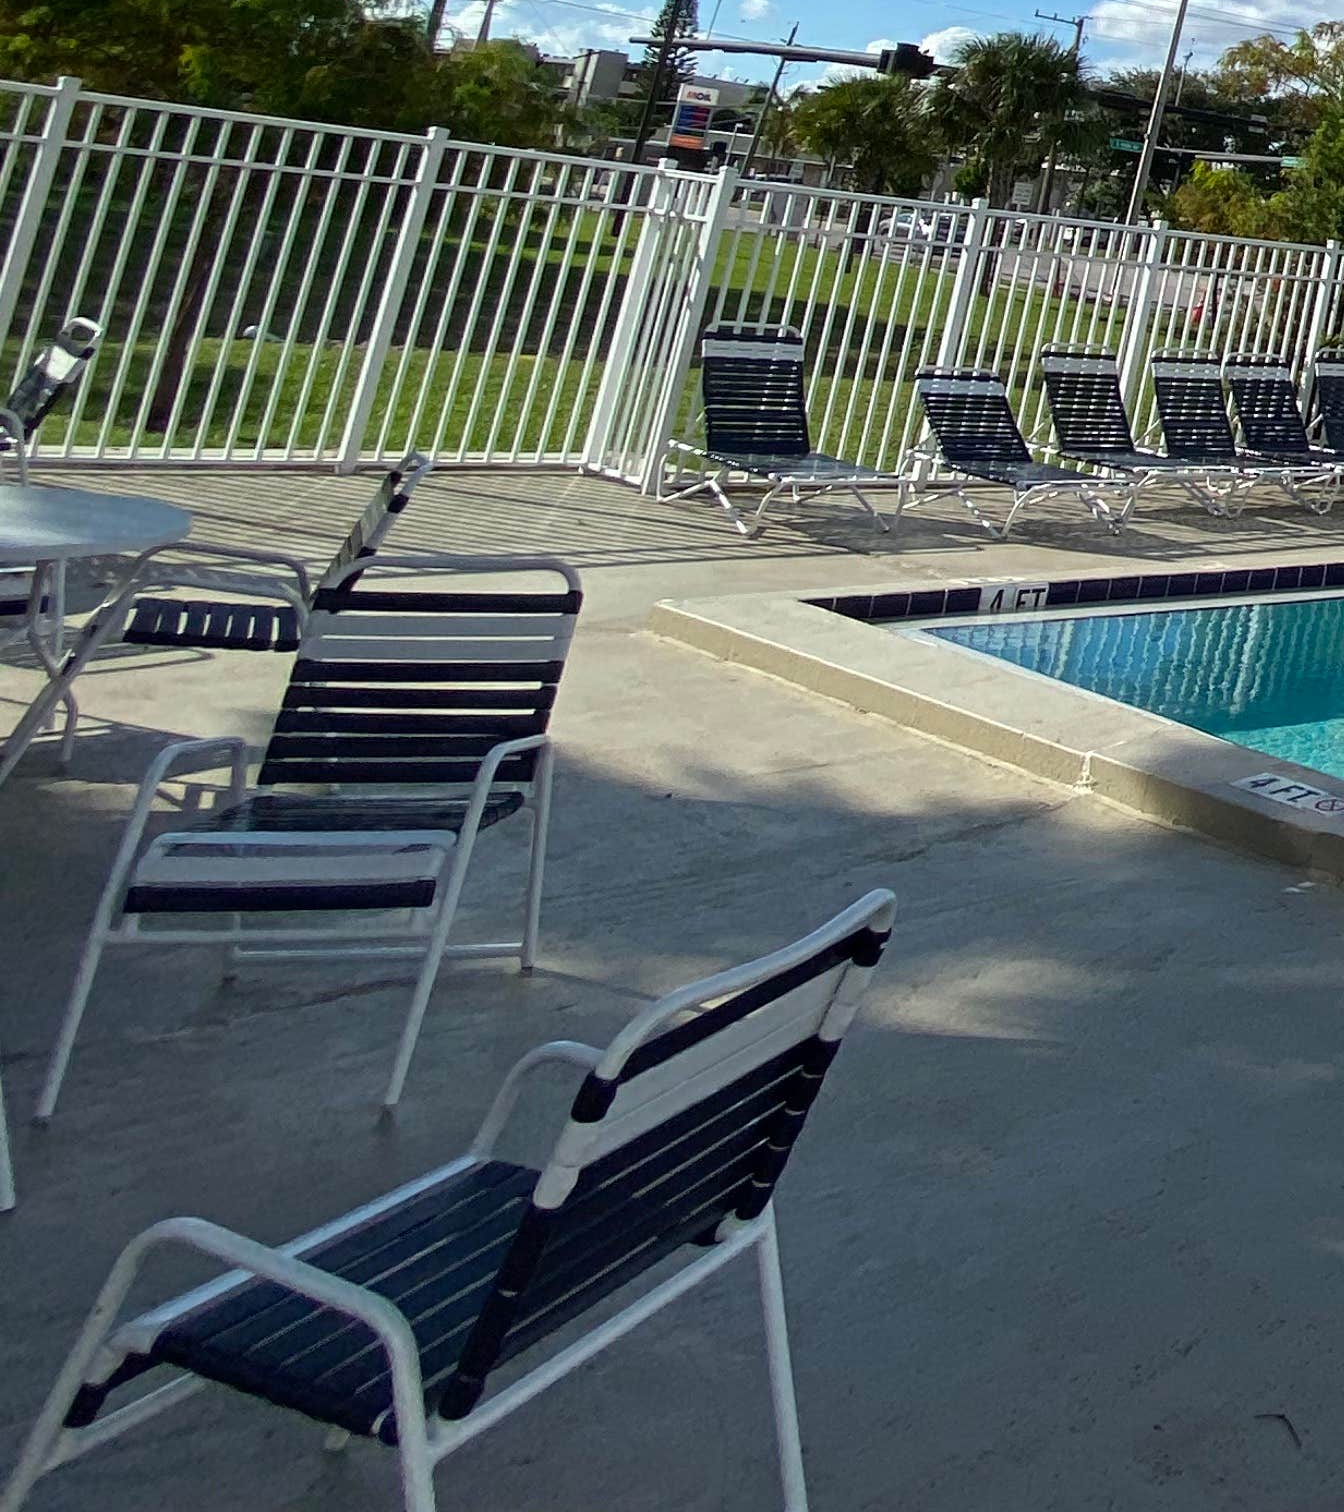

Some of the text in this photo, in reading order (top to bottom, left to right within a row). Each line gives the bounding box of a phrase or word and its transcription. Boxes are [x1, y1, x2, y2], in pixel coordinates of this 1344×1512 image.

[1015, 588, 1047, 610] FT
[1250, 777, 1321, 803] 4 FT
